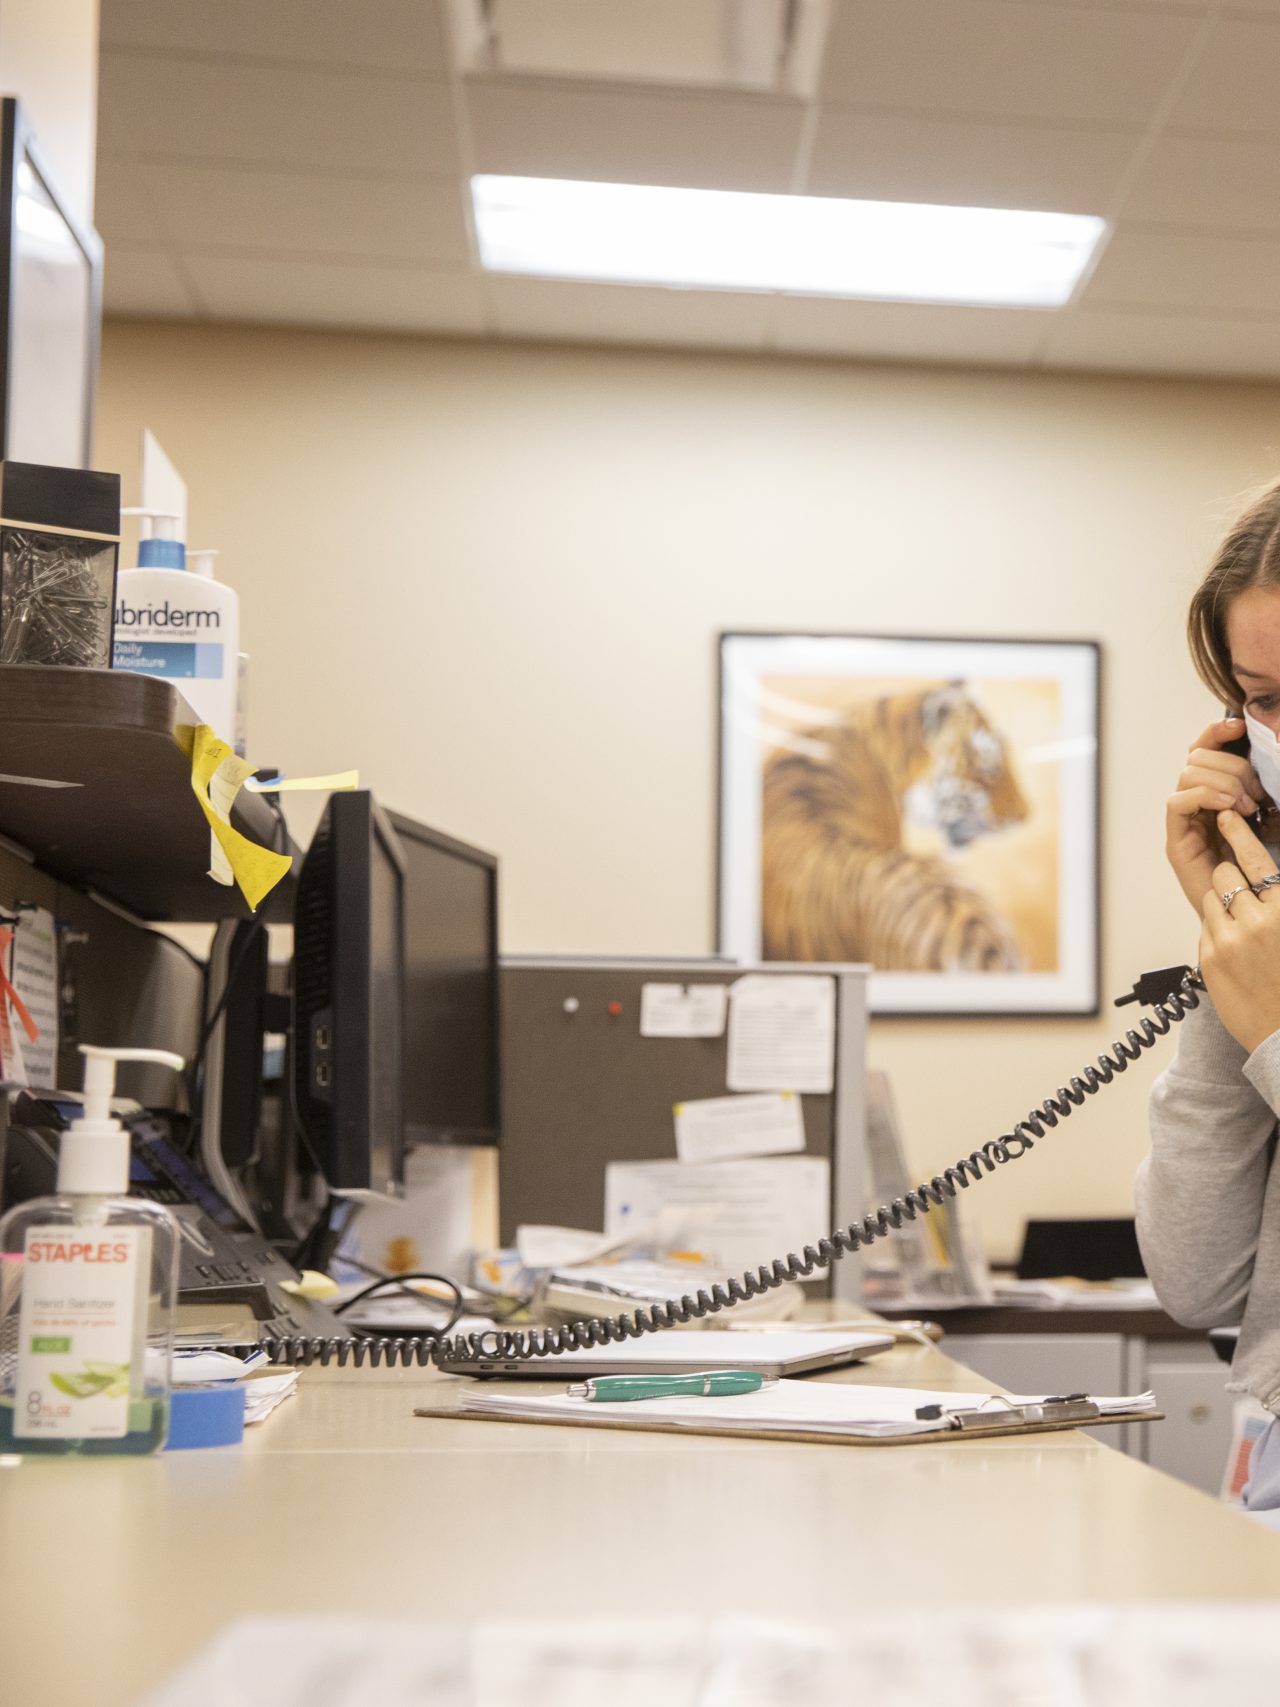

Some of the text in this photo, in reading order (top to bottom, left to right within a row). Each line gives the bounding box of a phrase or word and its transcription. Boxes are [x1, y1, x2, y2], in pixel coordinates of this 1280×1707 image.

[113, 643, 143, 656] Daily
[113, 655, 167, 668] Moisture
[28, 1242, 129, 1263] STAPLES
[26, 1391, 42, 1415] 8
